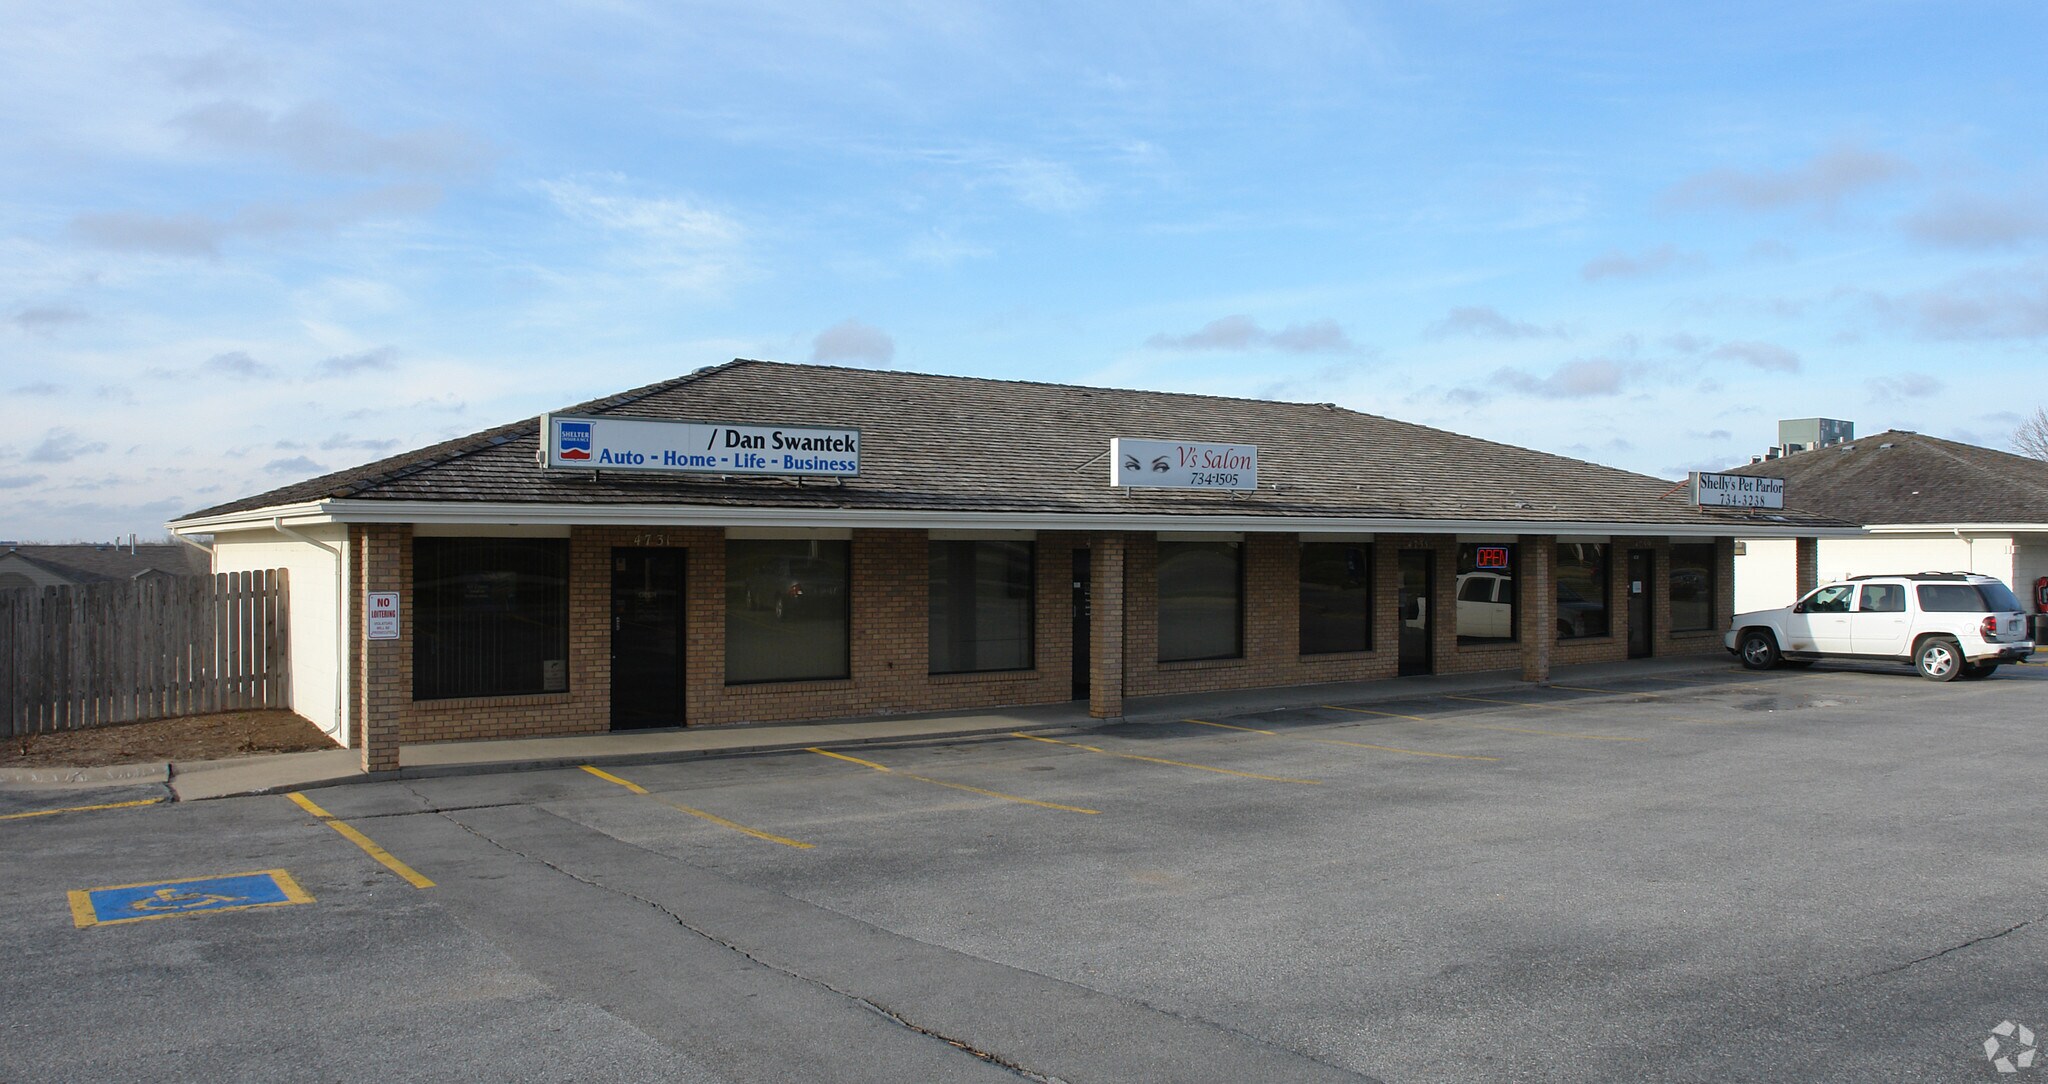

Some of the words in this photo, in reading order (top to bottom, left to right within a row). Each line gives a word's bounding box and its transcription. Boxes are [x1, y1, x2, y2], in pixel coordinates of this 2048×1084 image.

[562, 430, 589, 438] SHELTER
[725, 429, 766, 449] Dan
[772, 431, 857, 453] Swantek
[599, 448, 645, 465] Auto
[663, 450, 717, 467] Home
[734, 453, 767, 469] Life
[783, 455, 857, 472] Business
[1176, 446, 1199, 469] V's
[1202, 448, 1251, 470] Salon
[1190, 472, 1239, 485] 734-1505
[1701, 474, 1736, 492] Shelly's
[1738, 477, 1753, 492] Pet
[1756, 478, 1783, 494] Parlor
[1720, 494, 1766, 507] 734-3238
[1479, 549, 1507, 567] OPEN
[377, 598, 390, 607] NO
